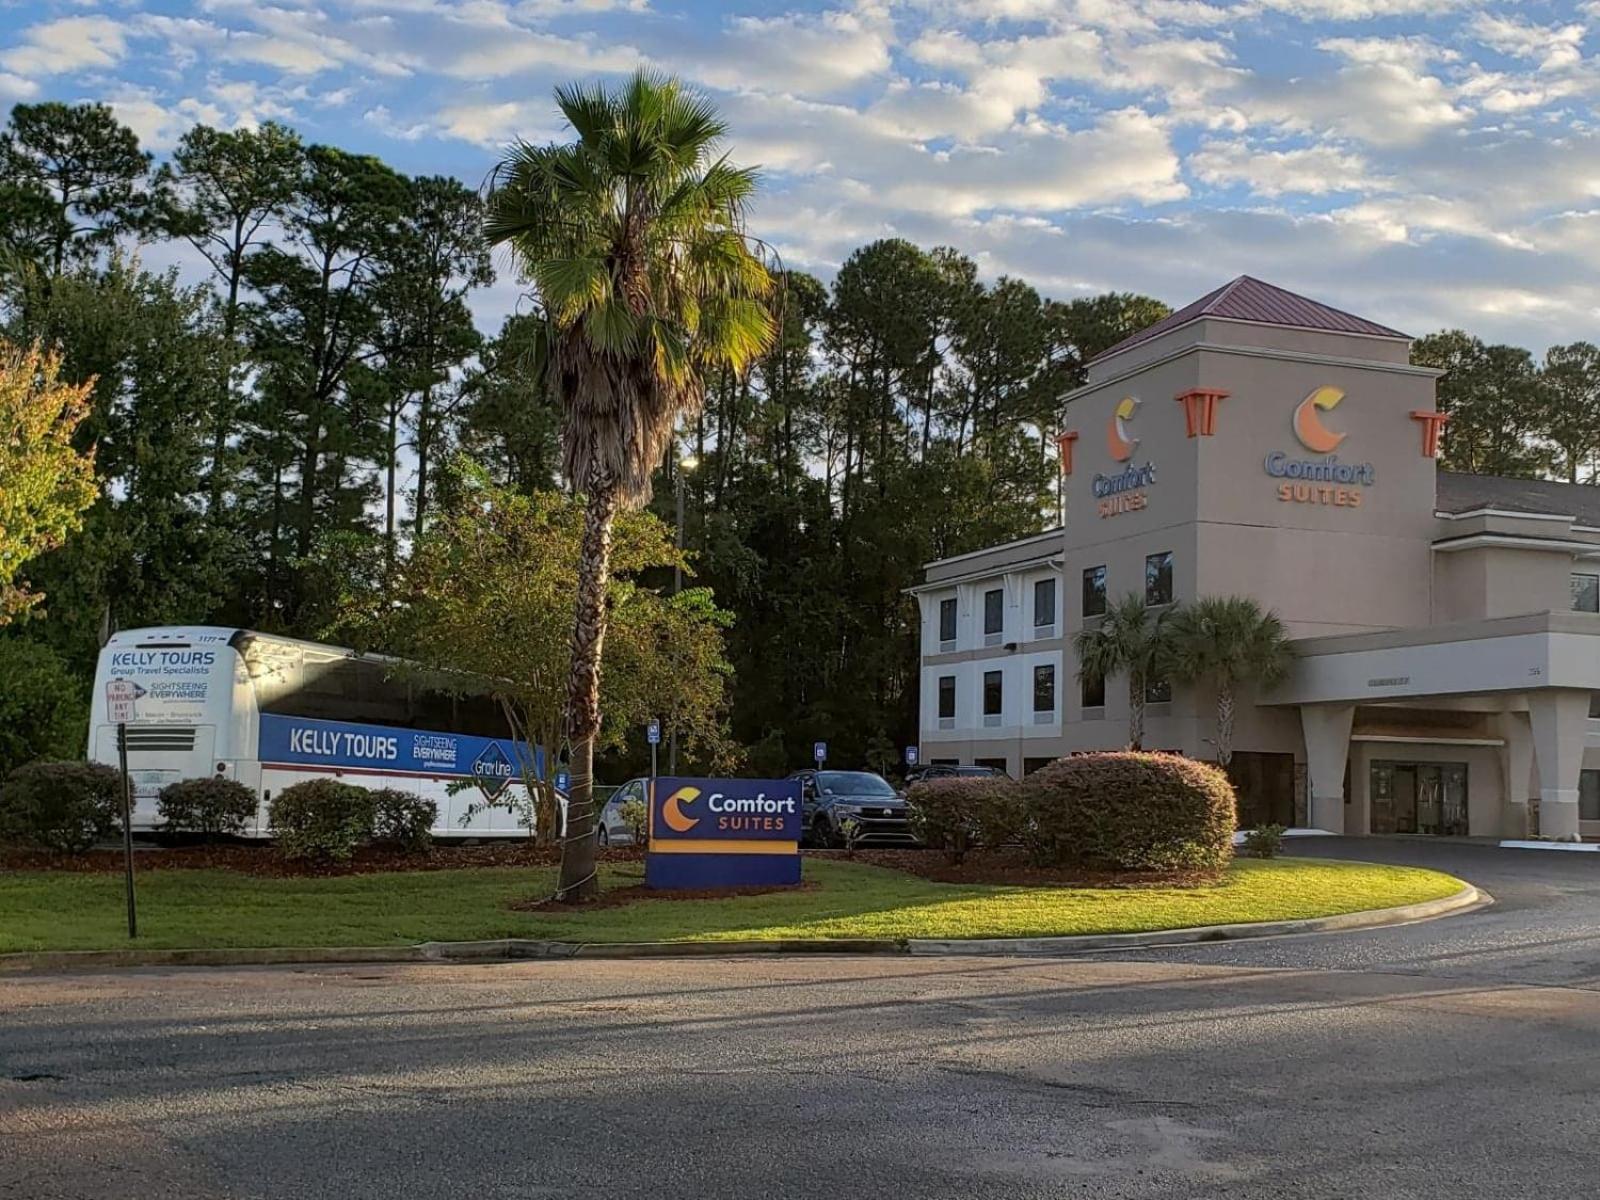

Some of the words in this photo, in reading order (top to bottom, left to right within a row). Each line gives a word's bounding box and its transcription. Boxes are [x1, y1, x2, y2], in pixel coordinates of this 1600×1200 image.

[1264, 451, 1375, 485] Comfort
[1092, 461, 1155, 498] Comfort
[1277, 482, 1361, 507] SUITES
[112, 652, 156, 666] KELLY
[160, 652, 215, 665] TOURS
[111, 667, 135, 676] Group
[138, 667, 162, 675] Travel
[165, 667, 209, 675] Specialists
[114, 684, 126, 692] NO
[152, 682, 208, 690] SIGHTSEEING
[107, 693, 134, 701] PARKING
[150, 690, 207, 699] EVERYWHERE
[114, 703, 128, 711] ANY
[290, 728, 341, 756] KELLY
[344, 733, 398, 760] TOURS
[414, 735, 457, 749] SIGHTSEEING
[413, 747, 457, 762] EVERYWHERE
[708, 794, 796, 814] Comfort
[718, 817, 785, 831] SUITES
